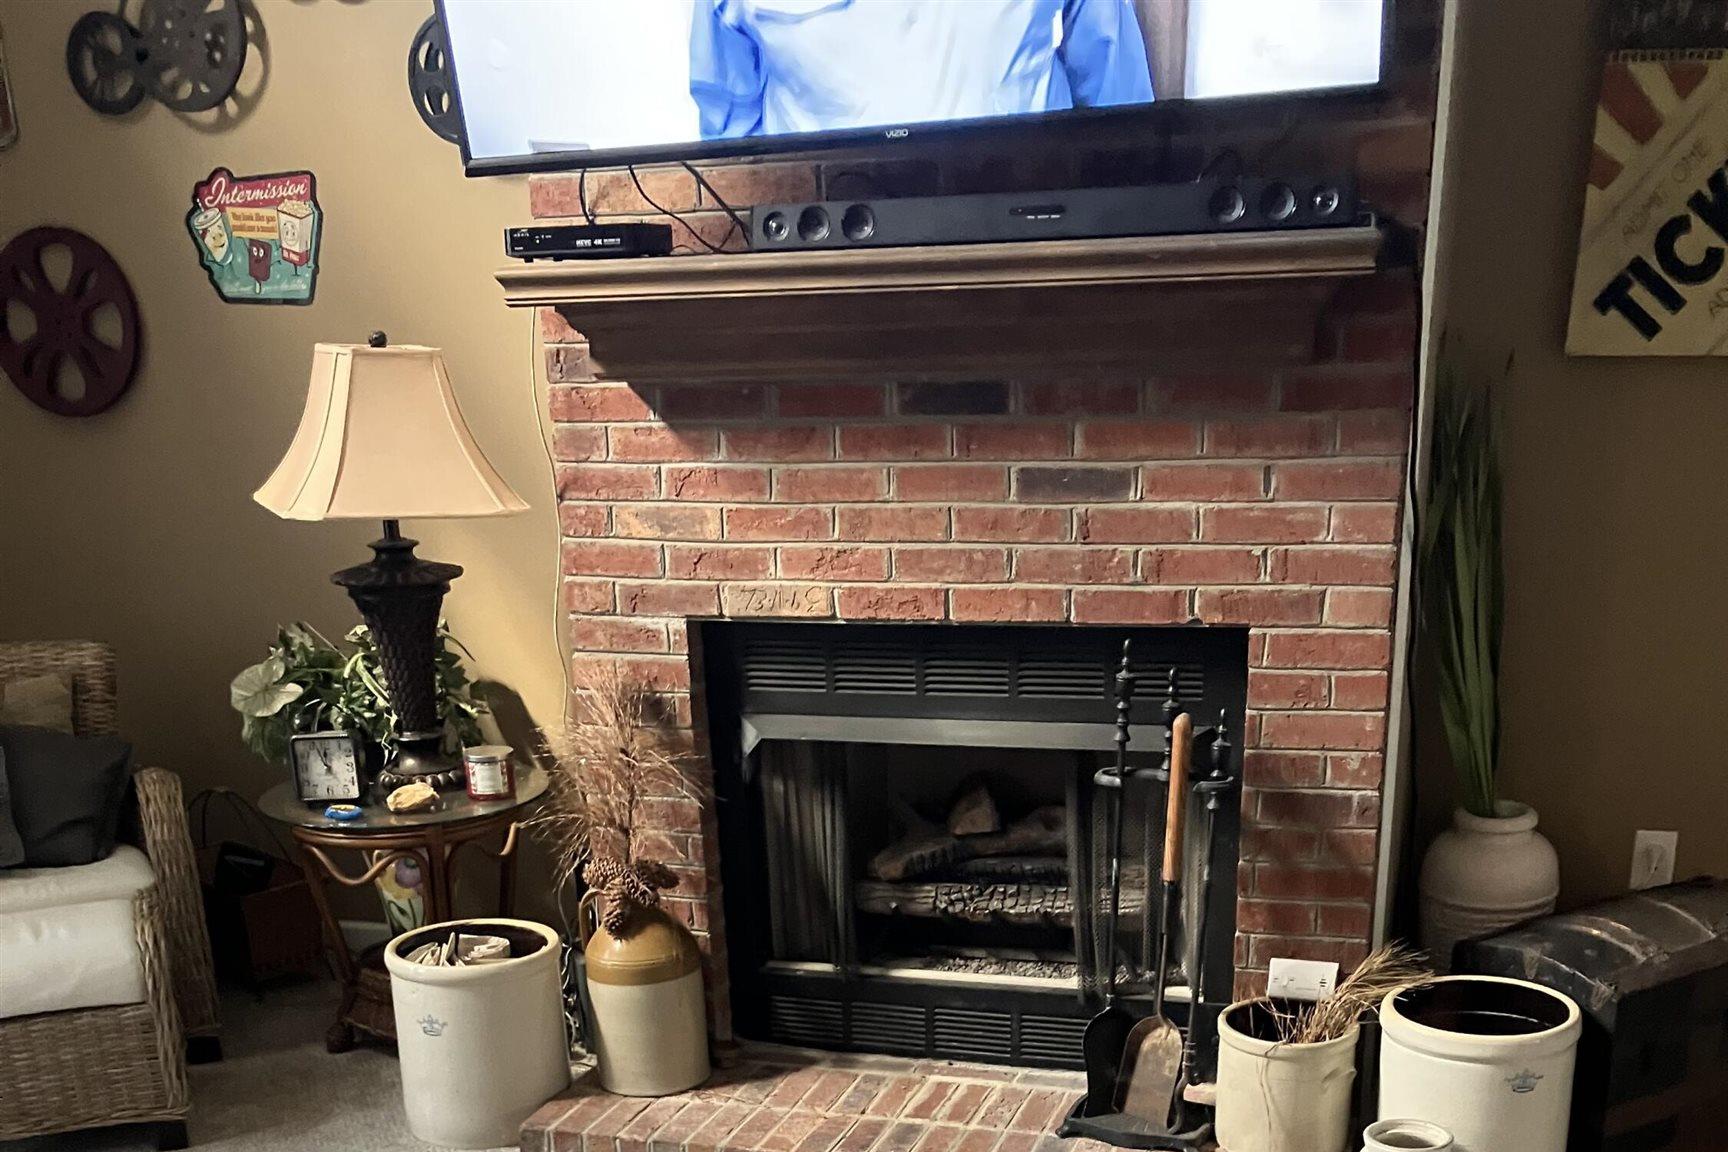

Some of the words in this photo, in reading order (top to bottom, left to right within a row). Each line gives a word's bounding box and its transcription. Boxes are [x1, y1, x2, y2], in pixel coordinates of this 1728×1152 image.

[886, 128, 909, 139] VIZIO
[204, 176, 309, 208] Intermission
[1592, 166, 1728, 343] TICK
